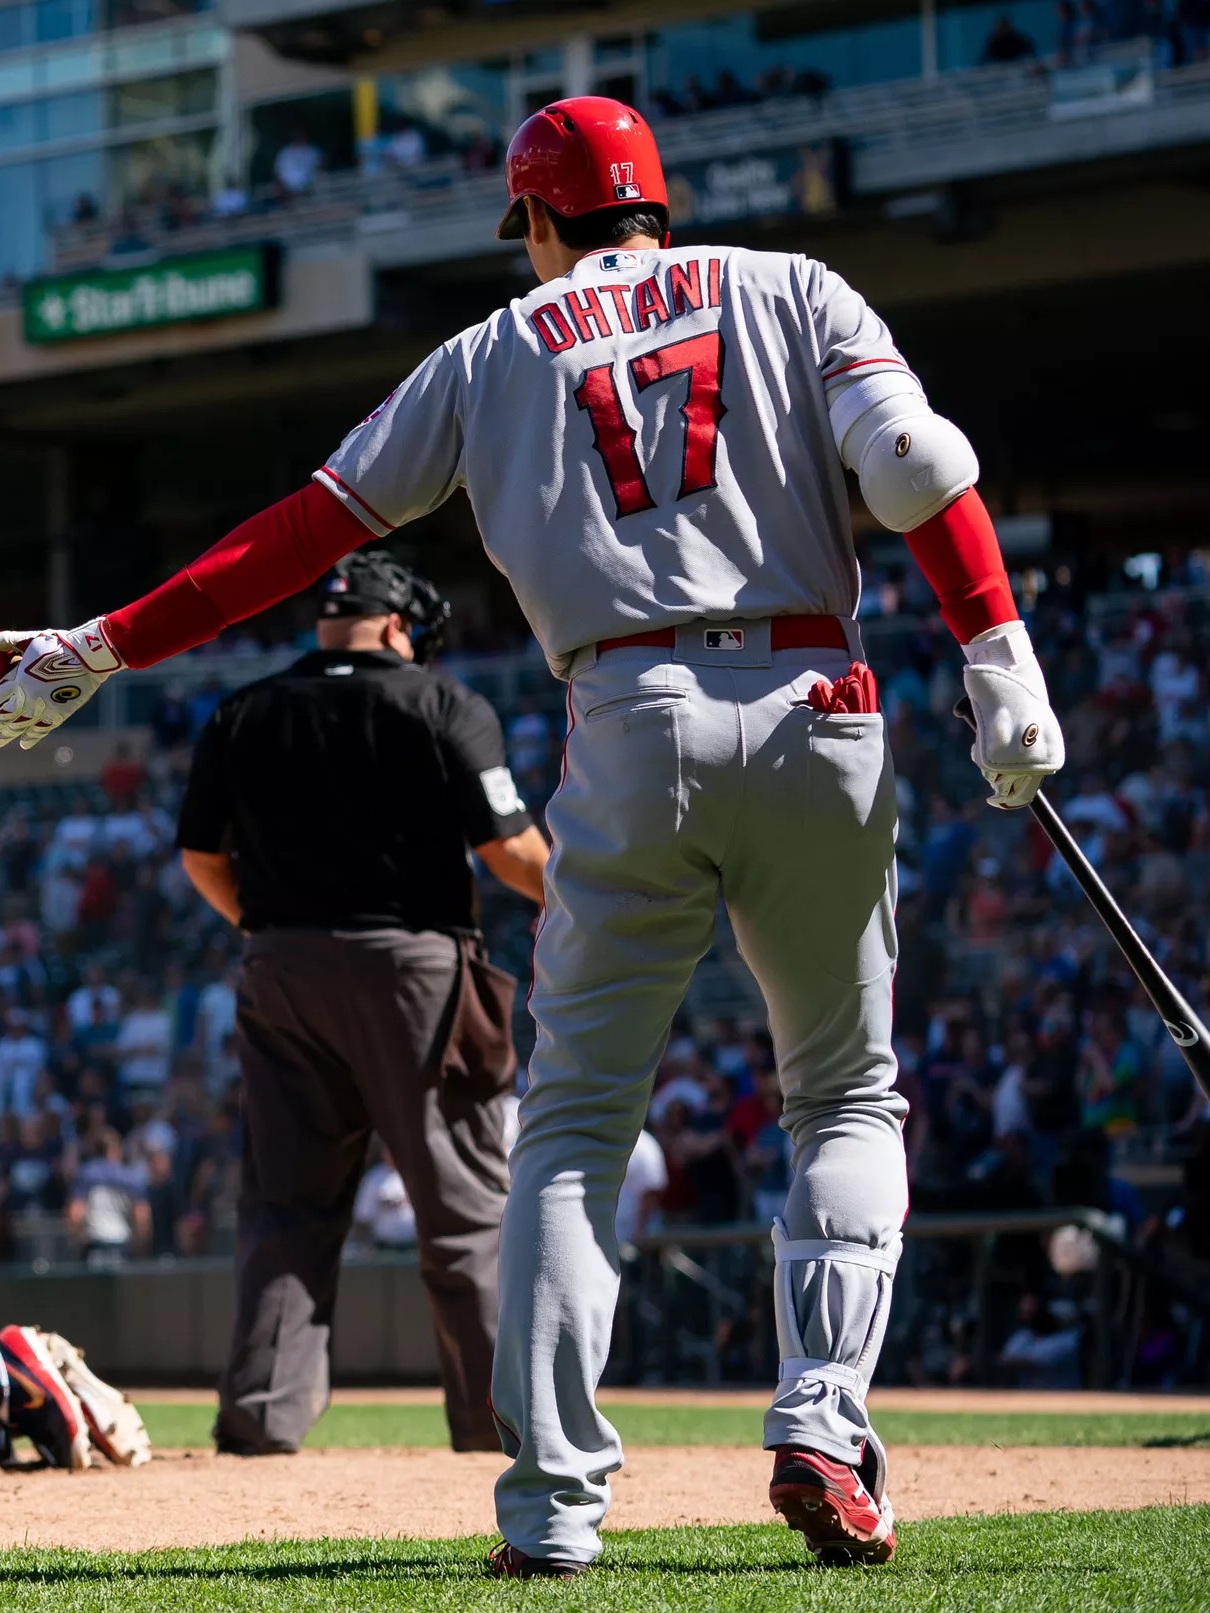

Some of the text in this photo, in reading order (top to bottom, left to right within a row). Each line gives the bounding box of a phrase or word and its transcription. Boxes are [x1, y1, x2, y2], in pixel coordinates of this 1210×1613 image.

[610, 162, 634, 185] 17
[530, 257, 722, 353] OHTANI
[573, 330, 728, 520] 17
